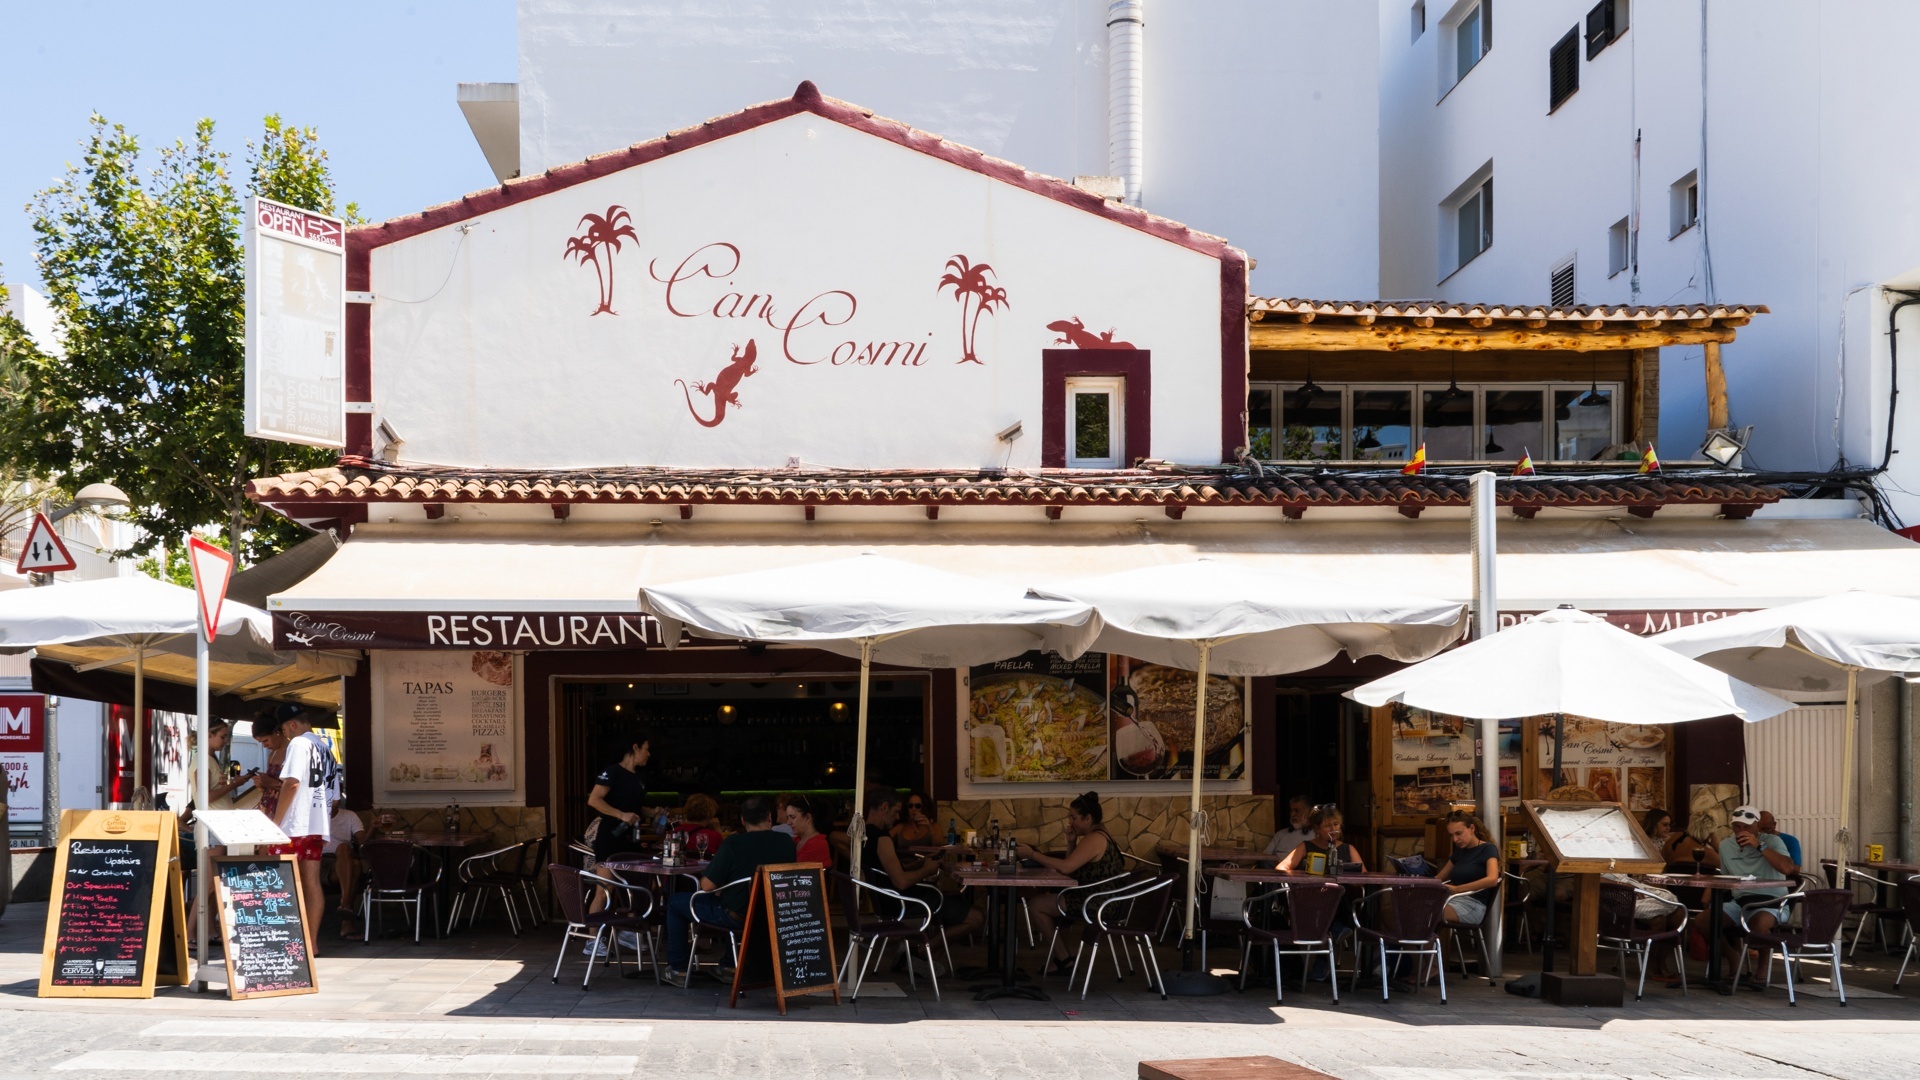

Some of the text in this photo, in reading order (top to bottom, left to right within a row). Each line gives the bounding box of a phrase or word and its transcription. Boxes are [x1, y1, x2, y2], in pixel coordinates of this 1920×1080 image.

[259, 202, 305, 220] RESTAURANT
[258, 210, 306, 237] OPEN
[308, 232, 337, 247] 365 DAYS
[649, 242, 773, 318] Can
[767, 290, 933, 367] Cosmi
[299, 383, 339, 404] GRILL
[298, 410, 329, 427] TAPAS
[326, 622, 376, 642] Cosmi
[994, 661, 1034, 670] PAELLA:
[403, 682, 454, 695] TAPAS
[1581, 741, 1613, 755] Cosmi
[1395, 753, 1419, 762] Cocktails
[1426, 753, 1448, 764] Lounge
[1586, 756, 1609, 765] Terrace
[1616, 756, 1634, 766] Grill
[1638, 756, 1657, 766] Tapas
[0, 762, 21, 771] OOD
[5, 771, 30, 790] ish
[71, 841, 132, 855] Restaurant
[104, 857, 141, 867] Upstairs
[91, 869, 134, 877] Conditioned
[66, 881, 82, 889] Our
[96, 894, 118, 902] Paella
[776, 891, 787, 900] MAR
[793, 890, 811, 899] TIERRA
